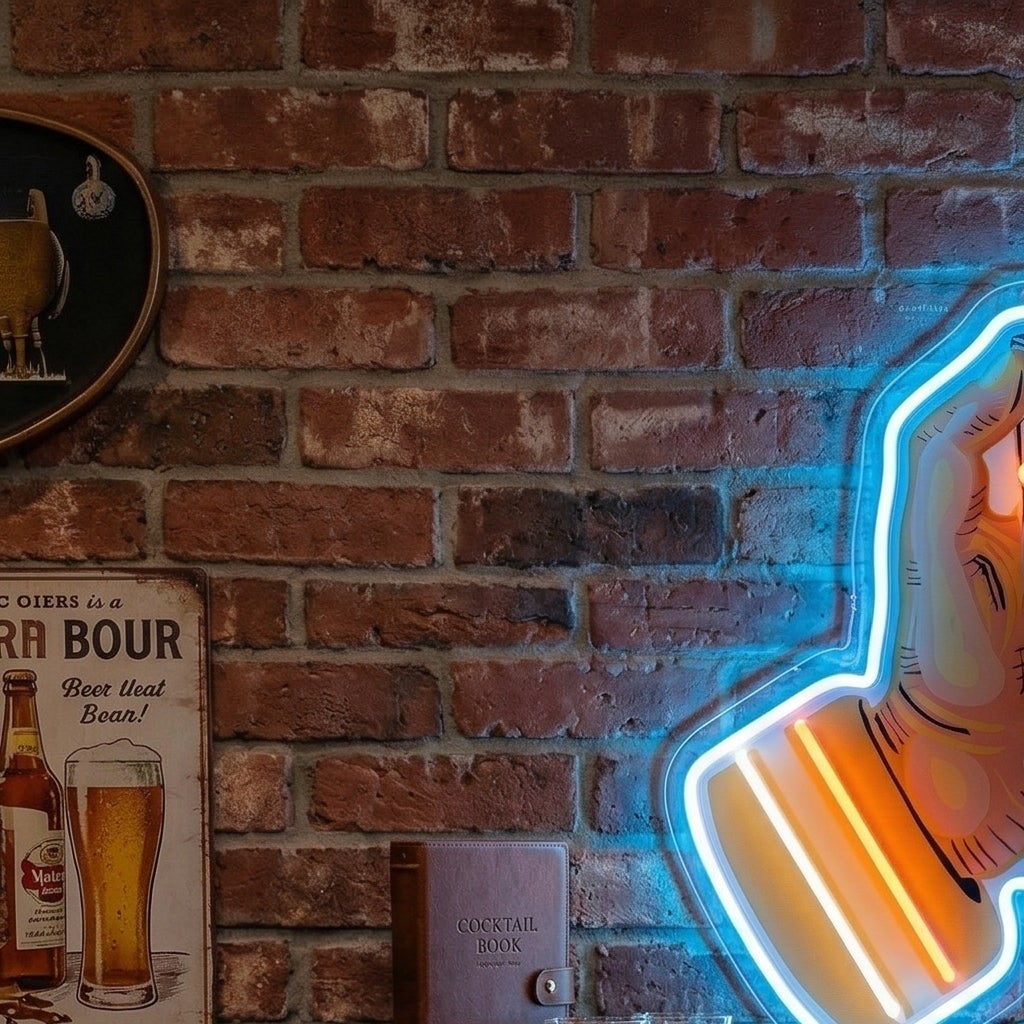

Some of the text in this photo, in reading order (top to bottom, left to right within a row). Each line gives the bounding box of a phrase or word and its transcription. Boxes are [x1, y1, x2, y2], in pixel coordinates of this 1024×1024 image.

[17, 595, 79, 609] OIERS
[87, 594, 105, 609] is
[109, 597, 124, 609] a
[63, 618, 183, 660] BOUR
[61, 677, 112, 698] Beer
[476, 937, 522, 954] BOOK
